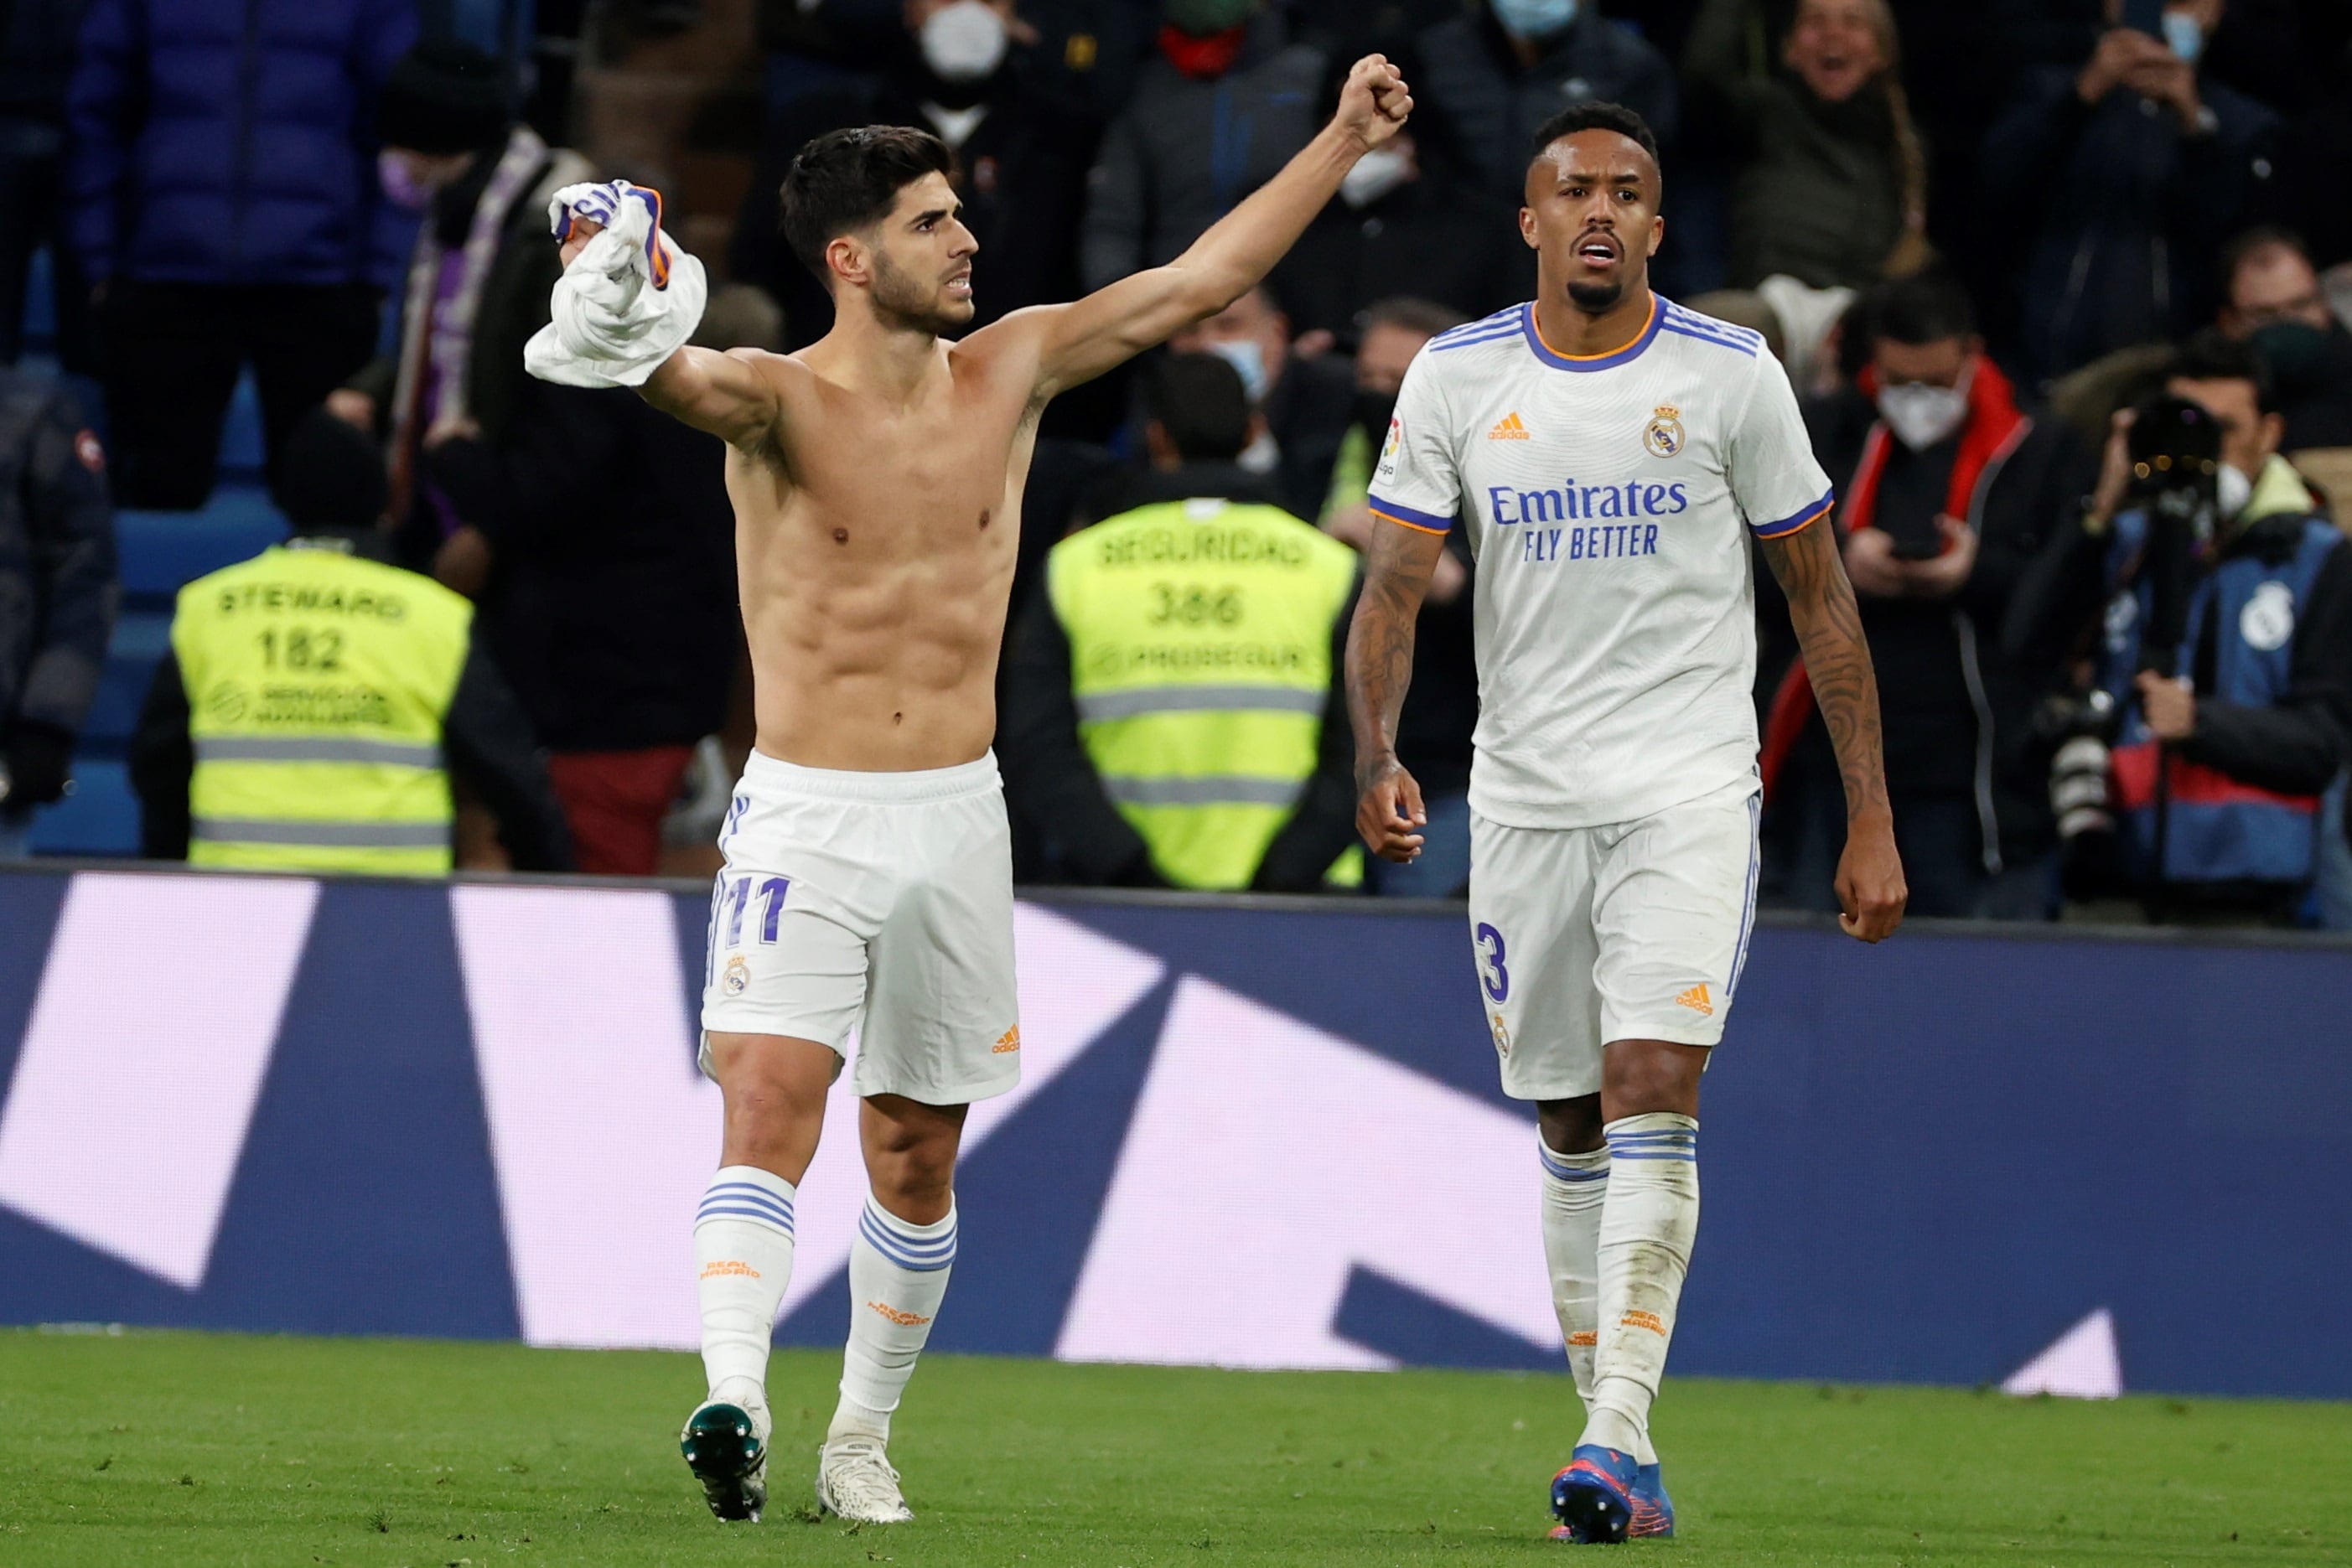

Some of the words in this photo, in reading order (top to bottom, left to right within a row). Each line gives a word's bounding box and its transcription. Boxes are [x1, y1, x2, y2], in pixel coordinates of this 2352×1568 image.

[1487, 428, 1530, 441] adidas
[1488, 478, 1687, 525] Emirates
[1525, 529, 1562, 561] FLY
[1570, 524, 1658, 560] BETTER
[218, 584, 409, 624] STEWARD
[258, 627, 342, 671] 182
[725, 877, 790, 950] 11
[1477, 922, 1509, 1004] 3
[1675, 996, 1713, 1016] adidas
[700, 1267, 761, 1281] MADRID
[707, 1260, 751, 1270] REAL
[1620, 1318, 1667, 1338] MADRID
[1630, 1310, 1660, 1325] REAL
